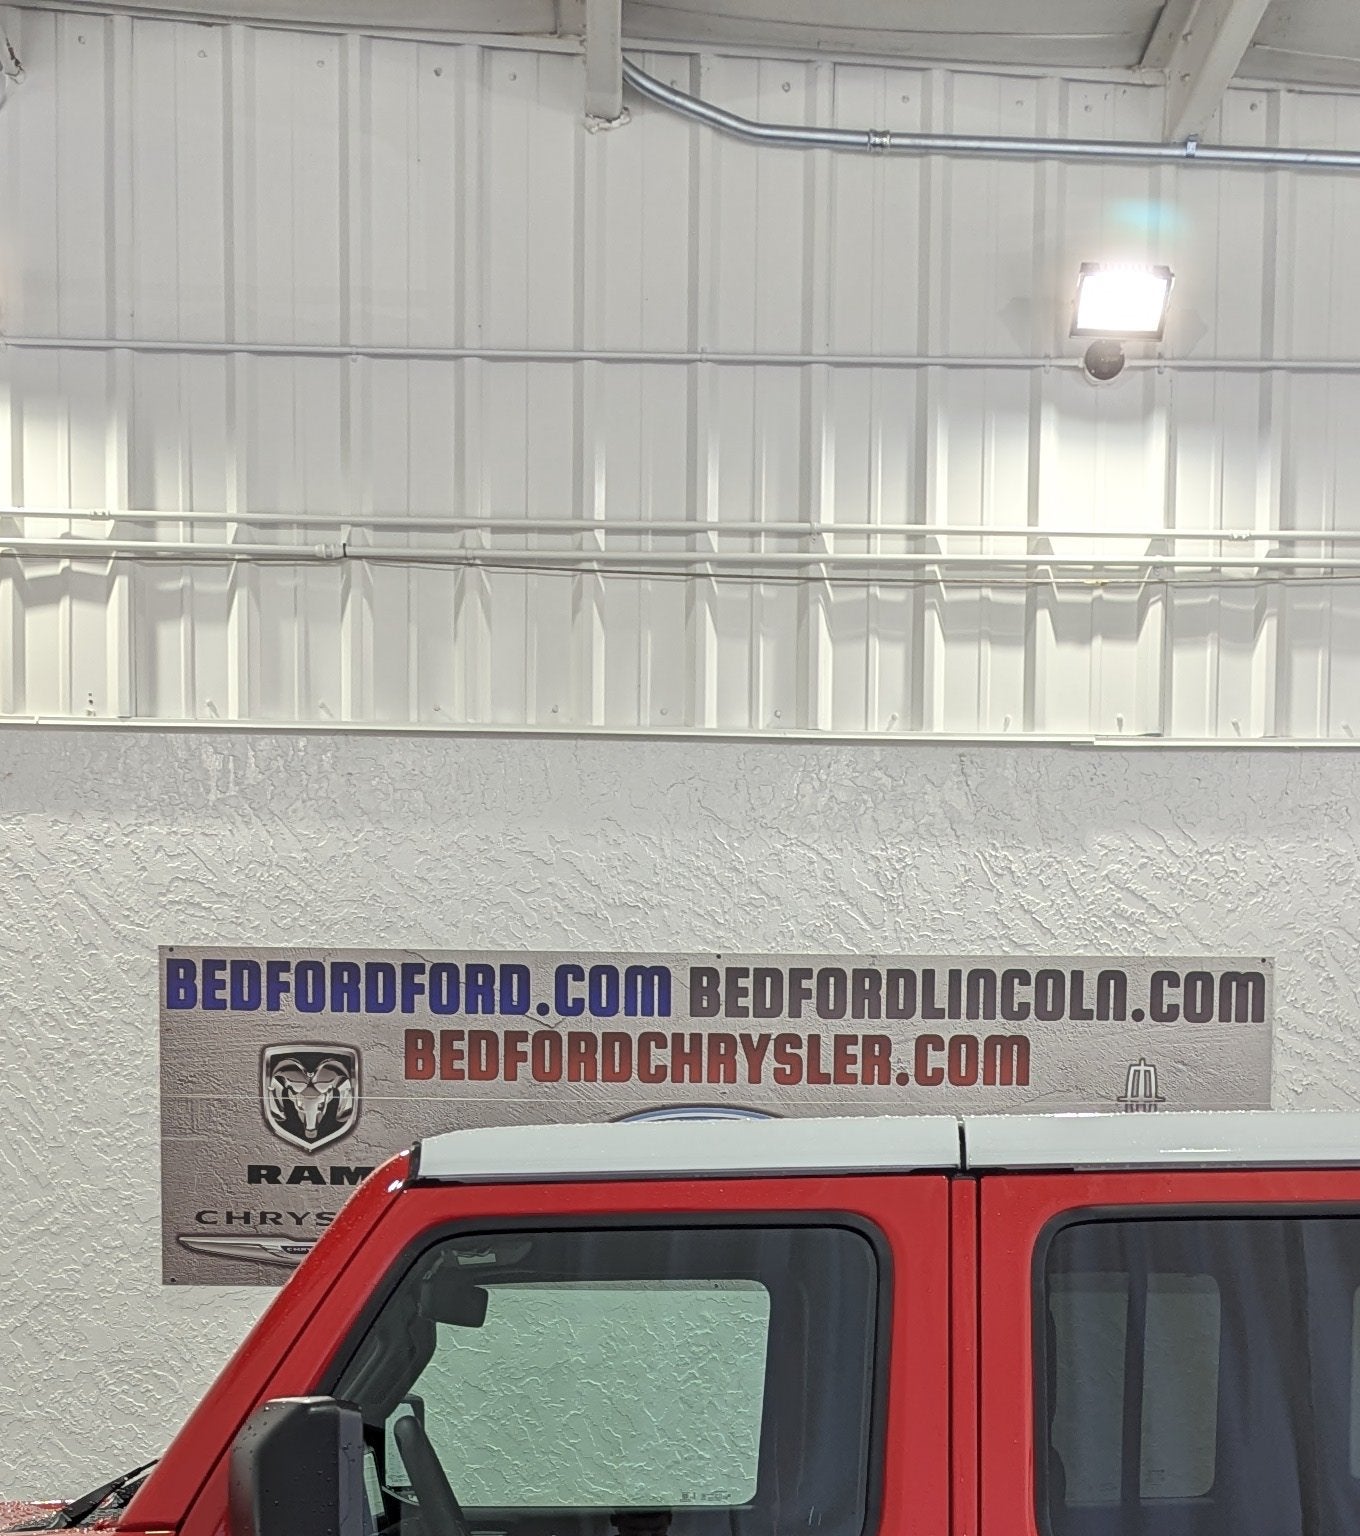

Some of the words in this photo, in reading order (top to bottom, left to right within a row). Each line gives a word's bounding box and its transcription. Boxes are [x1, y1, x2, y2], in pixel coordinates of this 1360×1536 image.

[166, 958, 671, 1017] BEDFORDFORD.COM
[690, 966, 1265, 1024] BEDFORDLINCOLN.COM
[405, 1029, 1030, 1086] BEDFORDCHRYSLER.COM
[247, 1164, 375, 1186] RAM
[195, 1210, 337, 1226] CHRYS
